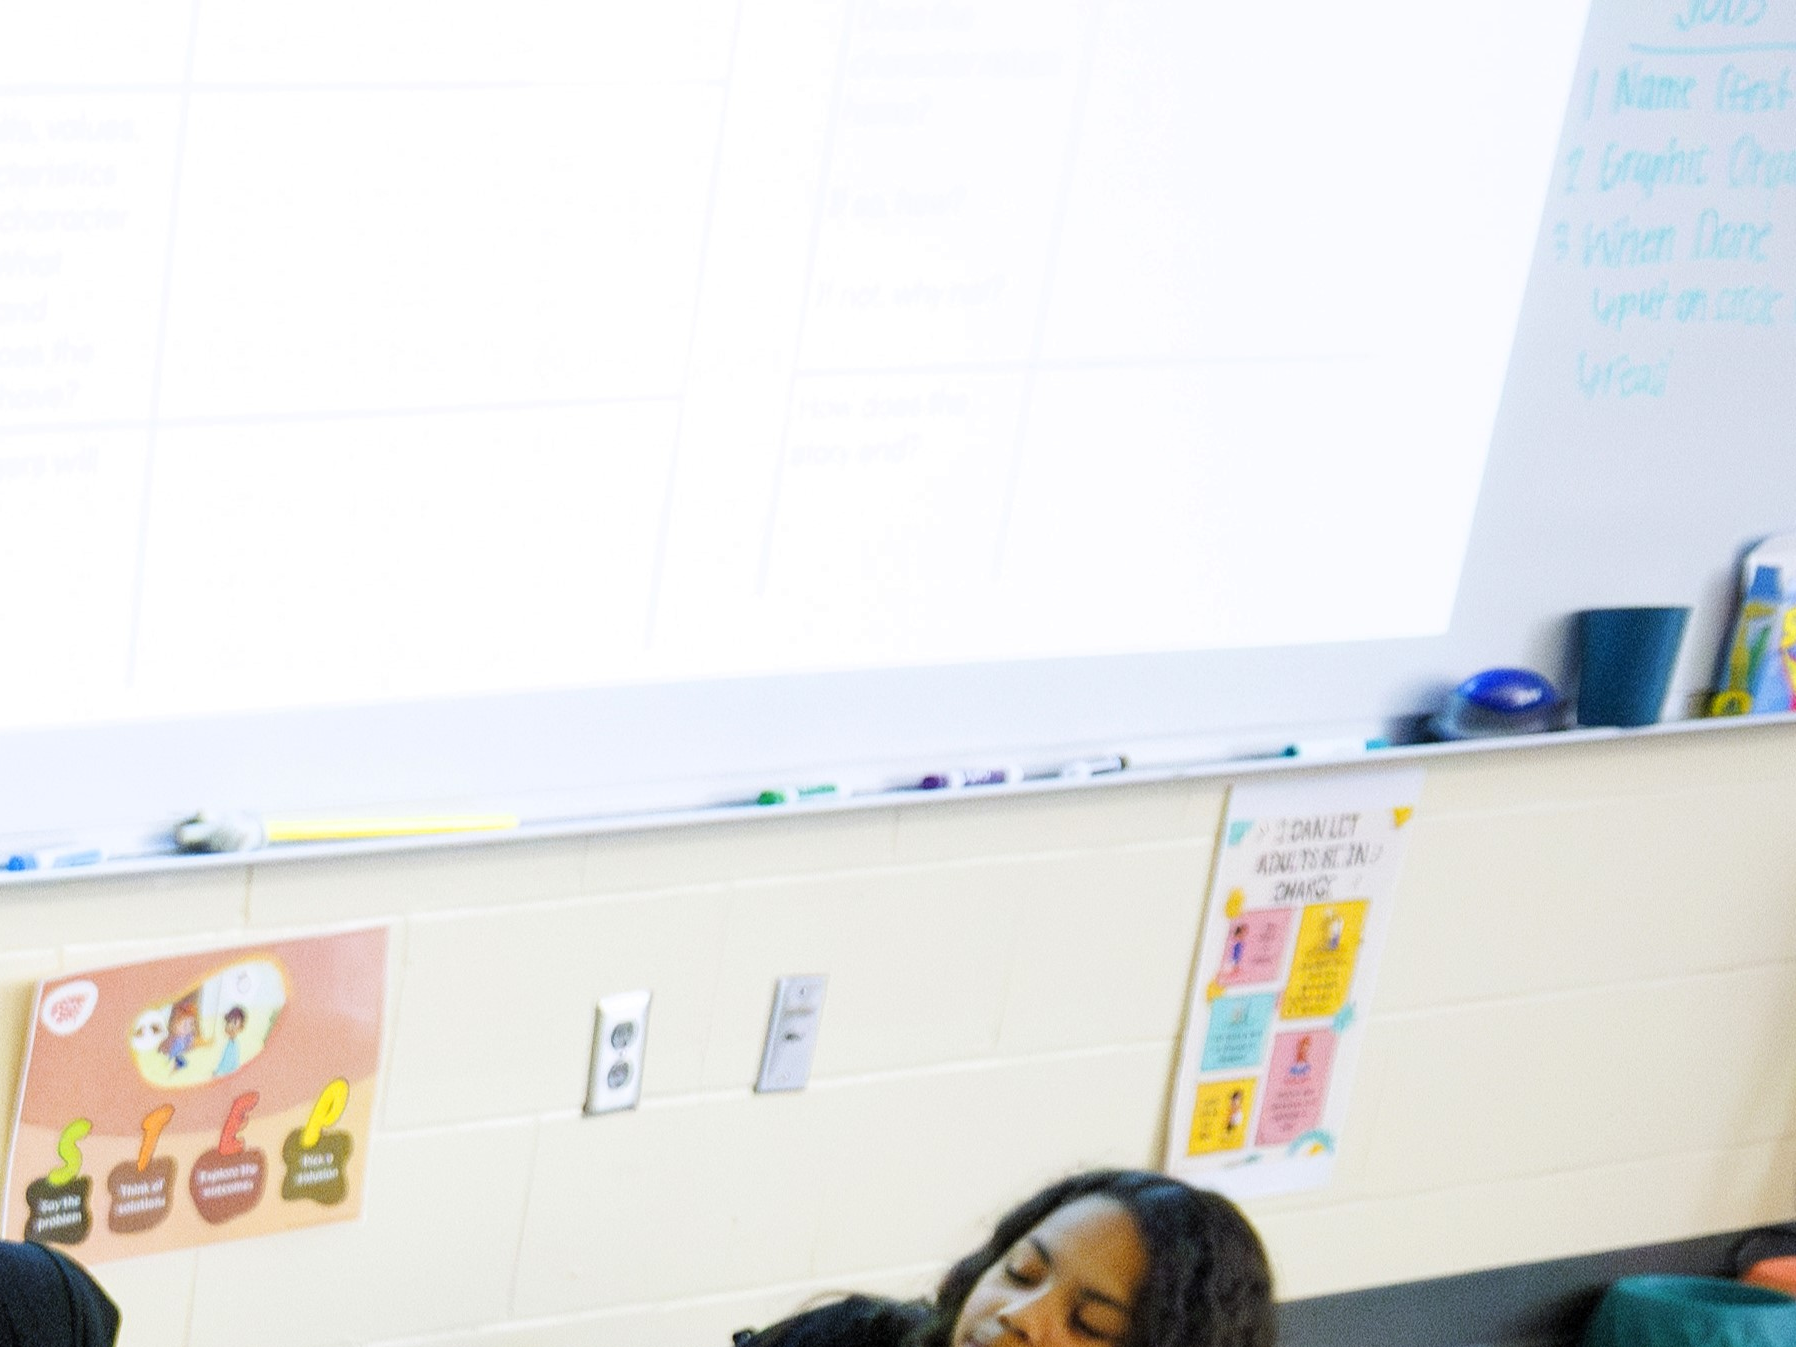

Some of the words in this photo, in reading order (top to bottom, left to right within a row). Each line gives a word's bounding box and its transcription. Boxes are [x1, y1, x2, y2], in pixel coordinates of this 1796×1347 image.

[1612, 61, 1696, 114] Name
[1600, 136, 1710, 198] Graphic
[1256, 848, 1319, 875] ADULTS
[48, 1117, 92, 1185] S
[137, 1103, 175, 1172] T
[219, 1091, 260, 1154] E
[301, 1076, 350, 1148] P
[304, 1155, 323, 1166] Pick
[199, 1168, 240, 1183] Explore
[241, 1163, 258, 1176] the
[296, 1167, 338, 1185] solution
[120, 1182, 149, 1197] Think
[151, 1178, 165, 1192] of
[202, 1181, 254, 1198] outcomes
[40, 1199, 60, 1213] Say
[63, 1195, 81, 1208] the
[117, 1197, 166, 1216] solutions
[36, 1212, 82, 1232] problem
